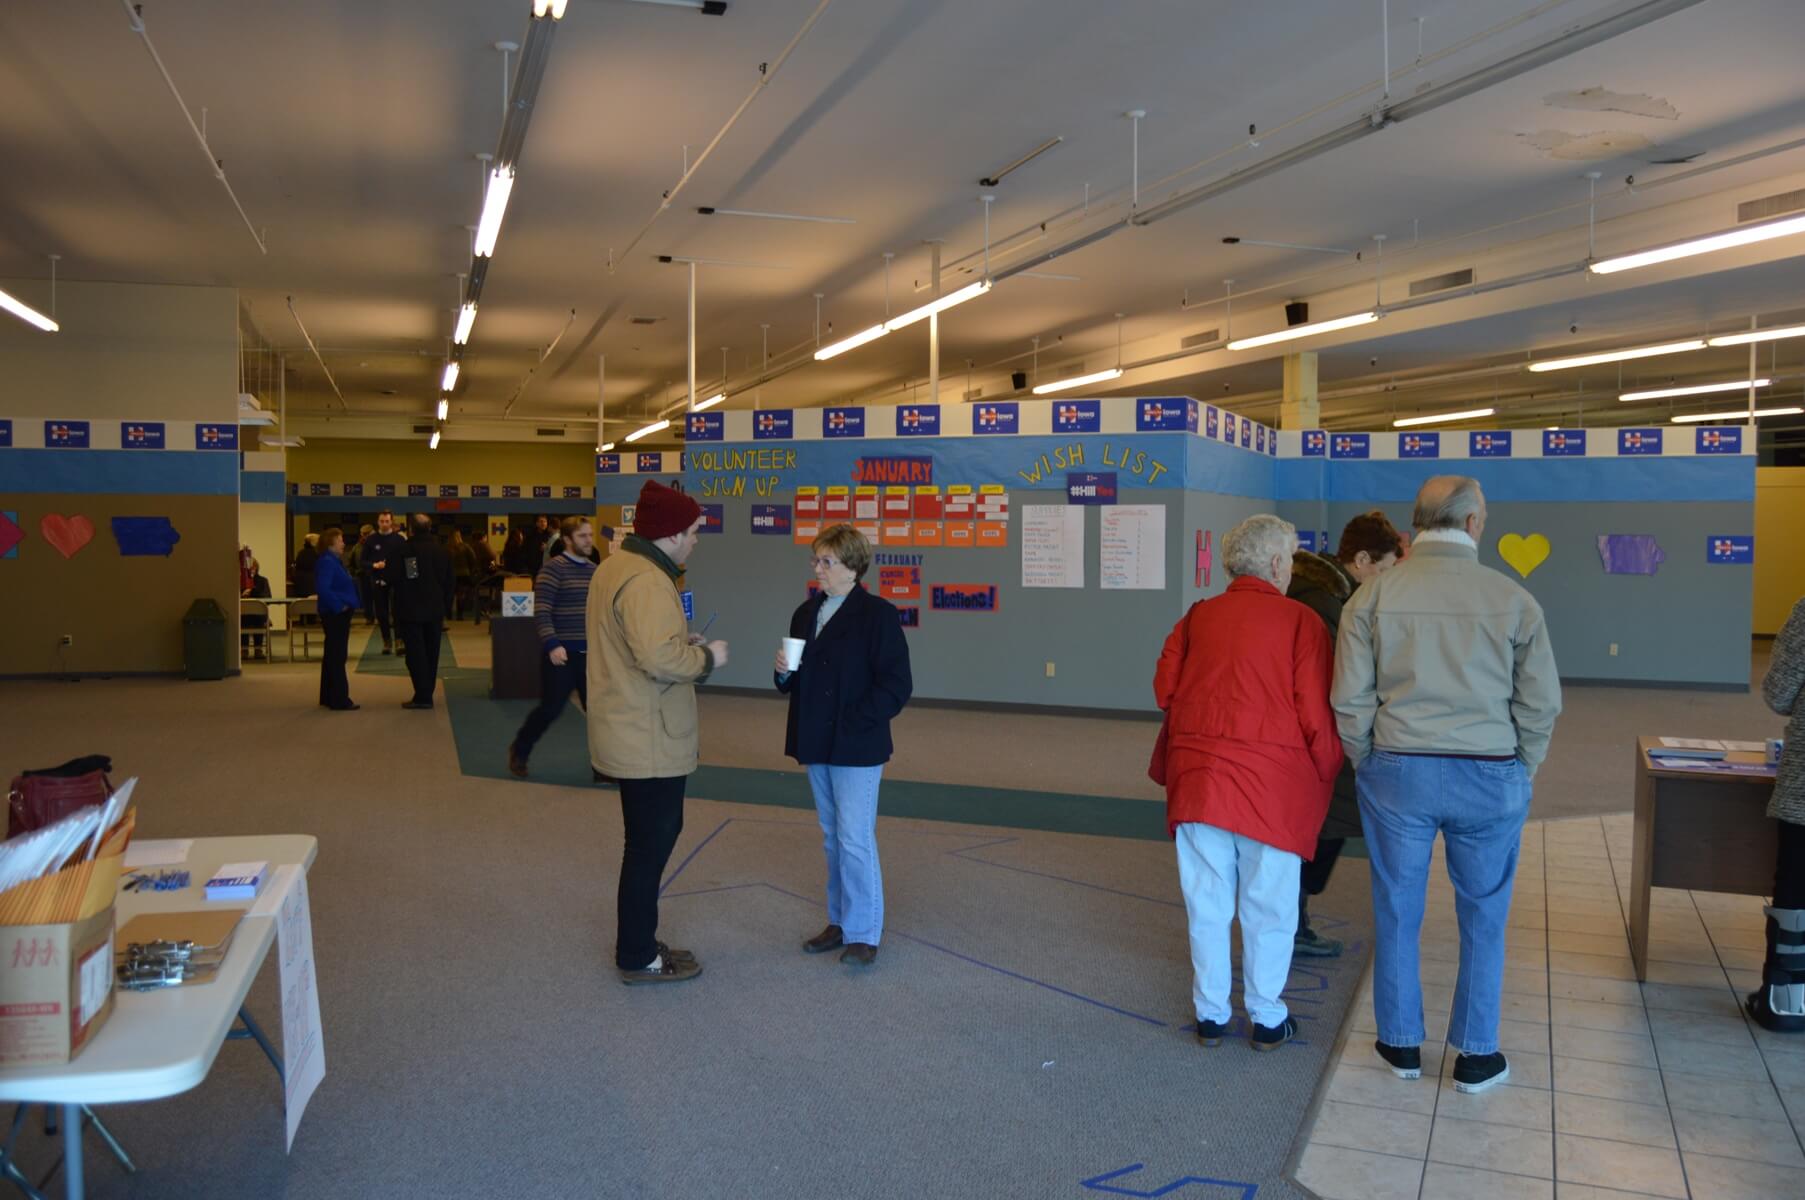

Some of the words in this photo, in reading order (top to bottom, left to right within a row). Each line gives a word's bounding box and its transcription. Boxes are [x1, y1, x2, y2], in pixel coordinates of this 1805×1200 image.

[1077, 410, 1095, 418] Iowa
[1163, 408, 1181, 416] Iowa
[690, 448, 797, 471] VOLUNTEER
[1019, 443, 1085, 485] WISH
[1103, 443, 1168, 485] LIST
[852, 459, 932, 483] JANUARY
[702, 476, 746, 497] SIGN
[755, 476, 780, 497] UP
[875, 553, 923, 566] FEBRUARY
[932, 586, 996, 609] Elections!
